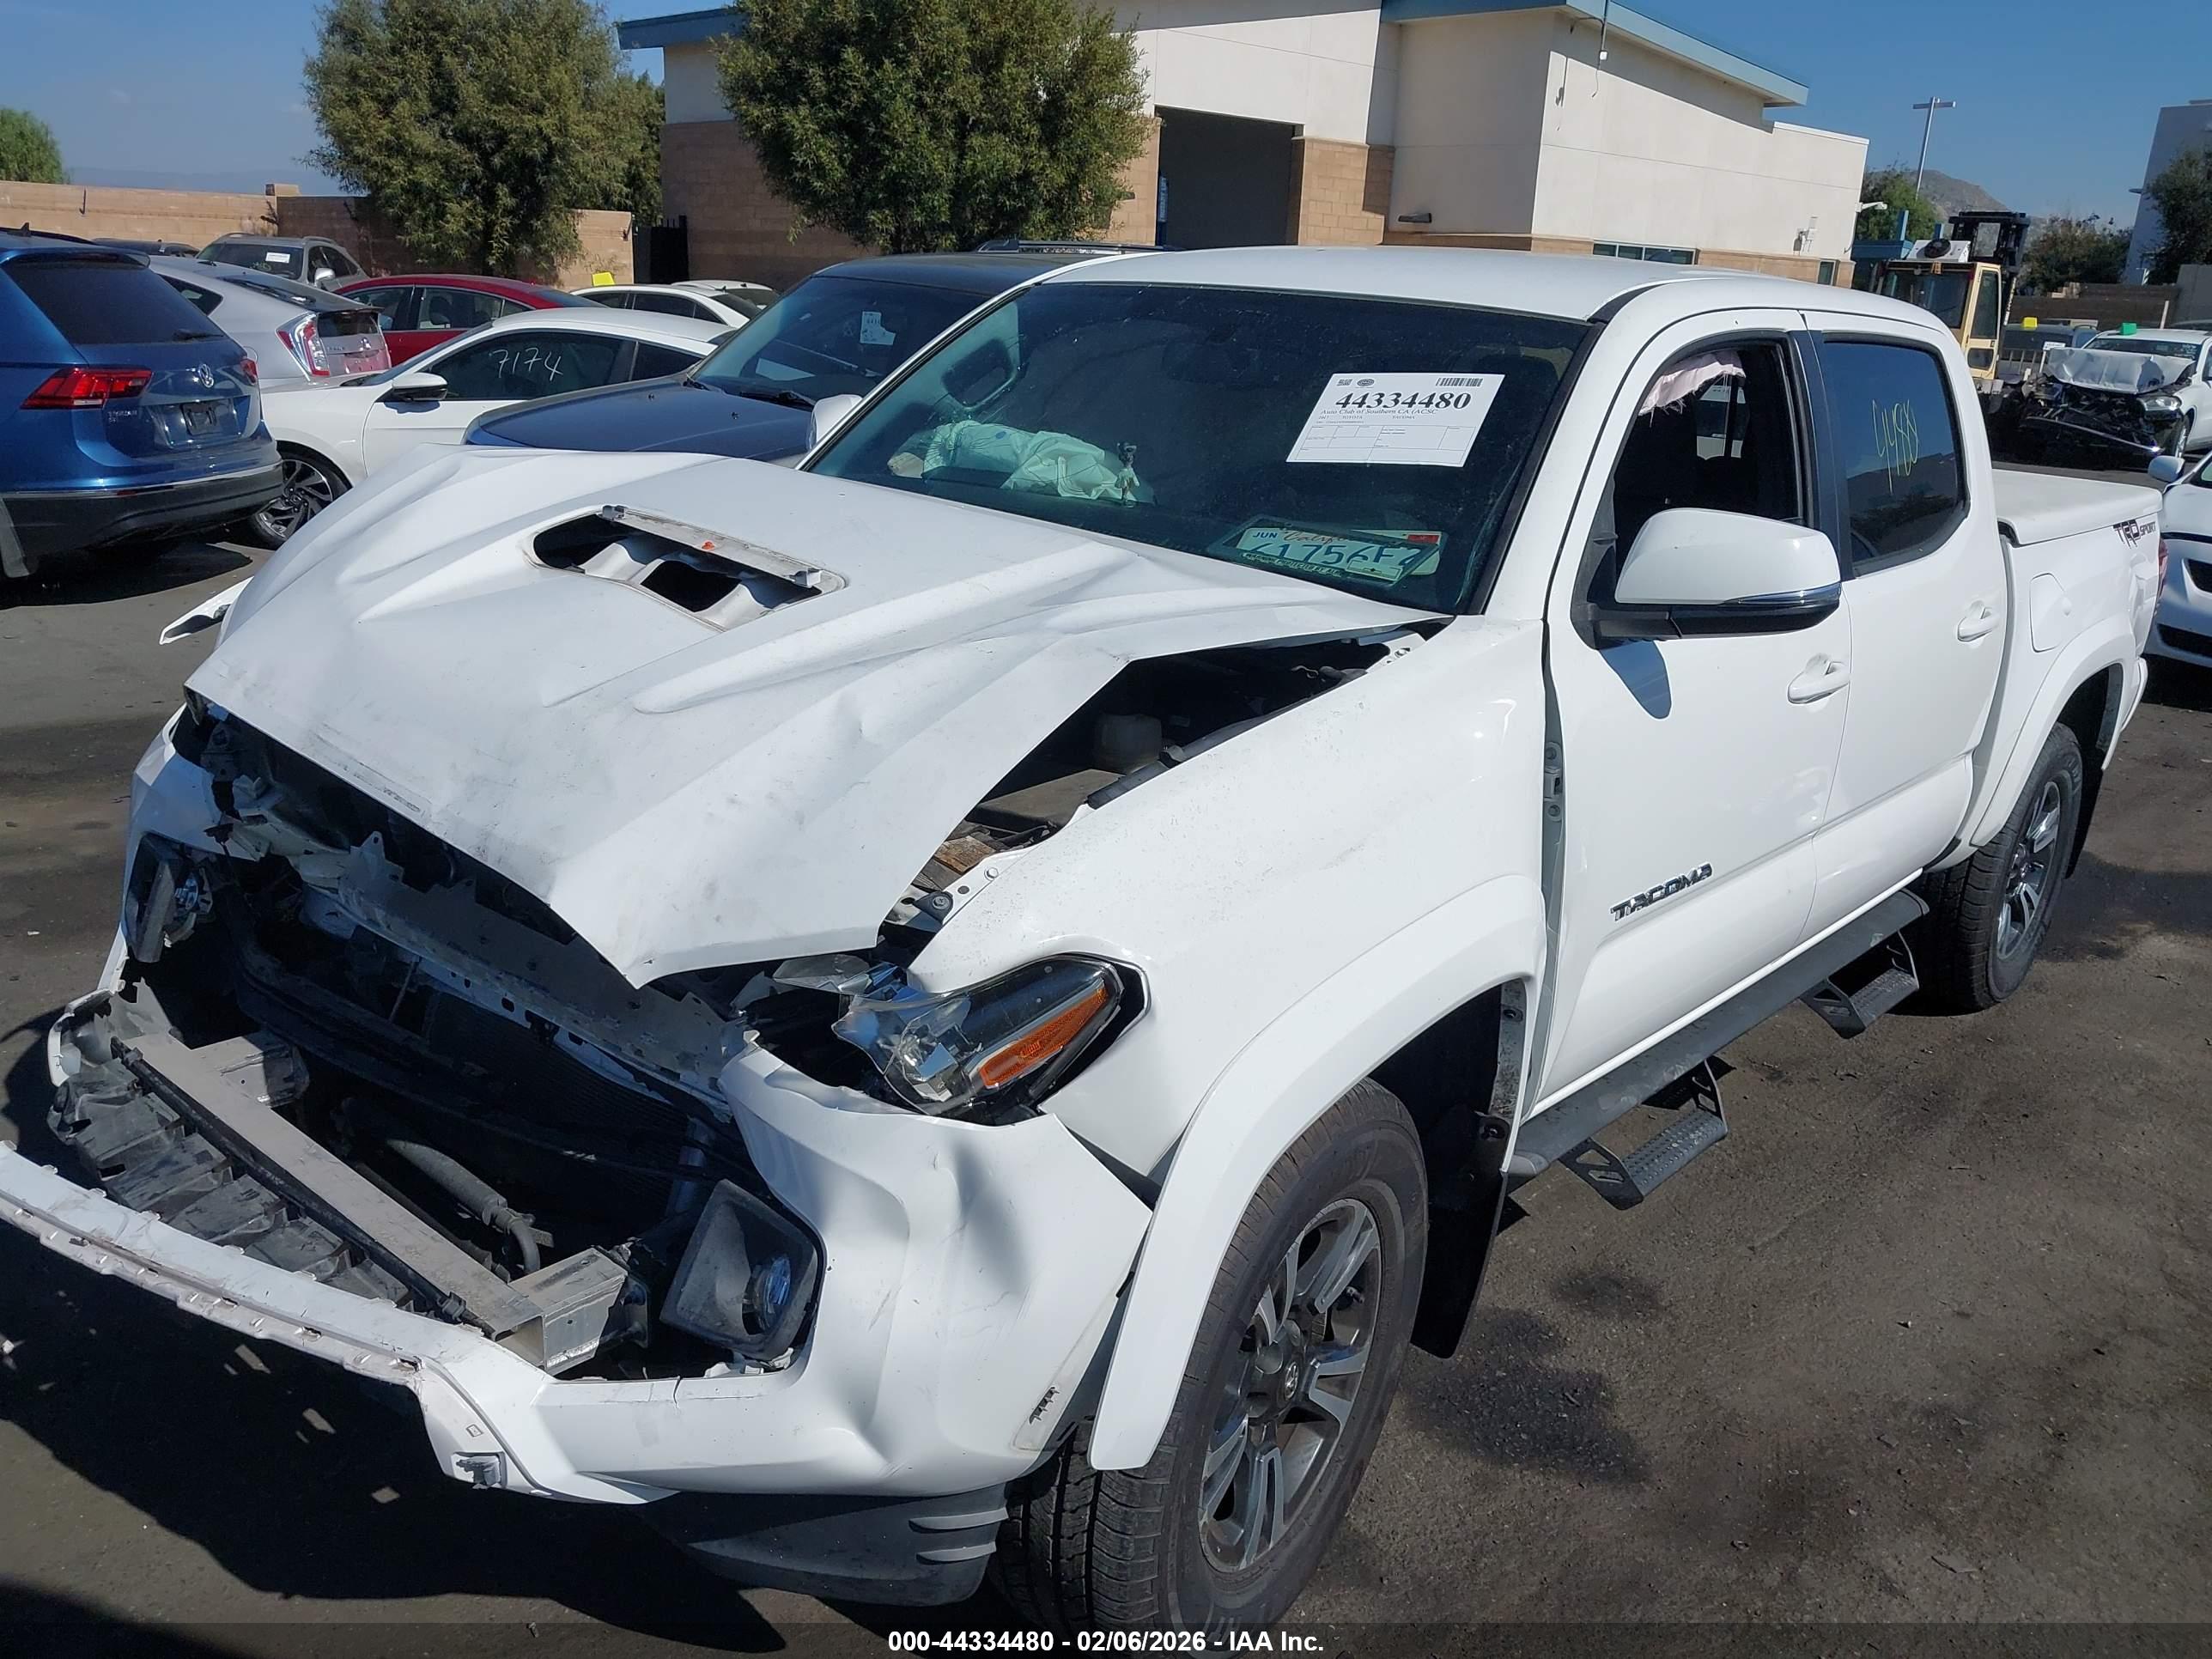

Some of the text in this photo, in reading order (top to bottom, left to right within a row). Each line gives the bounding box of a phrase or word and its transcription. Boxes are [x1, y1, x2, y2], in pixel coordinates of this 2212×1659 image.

[493, 347, 563, 381] 7174
[1335, 392, 1472, 410] 44334480
[1252, 531, 1279, 539] JUN
[2113, 519, 2142, 549] TRD
[1610, 862, 1712, 921] TACOMA
